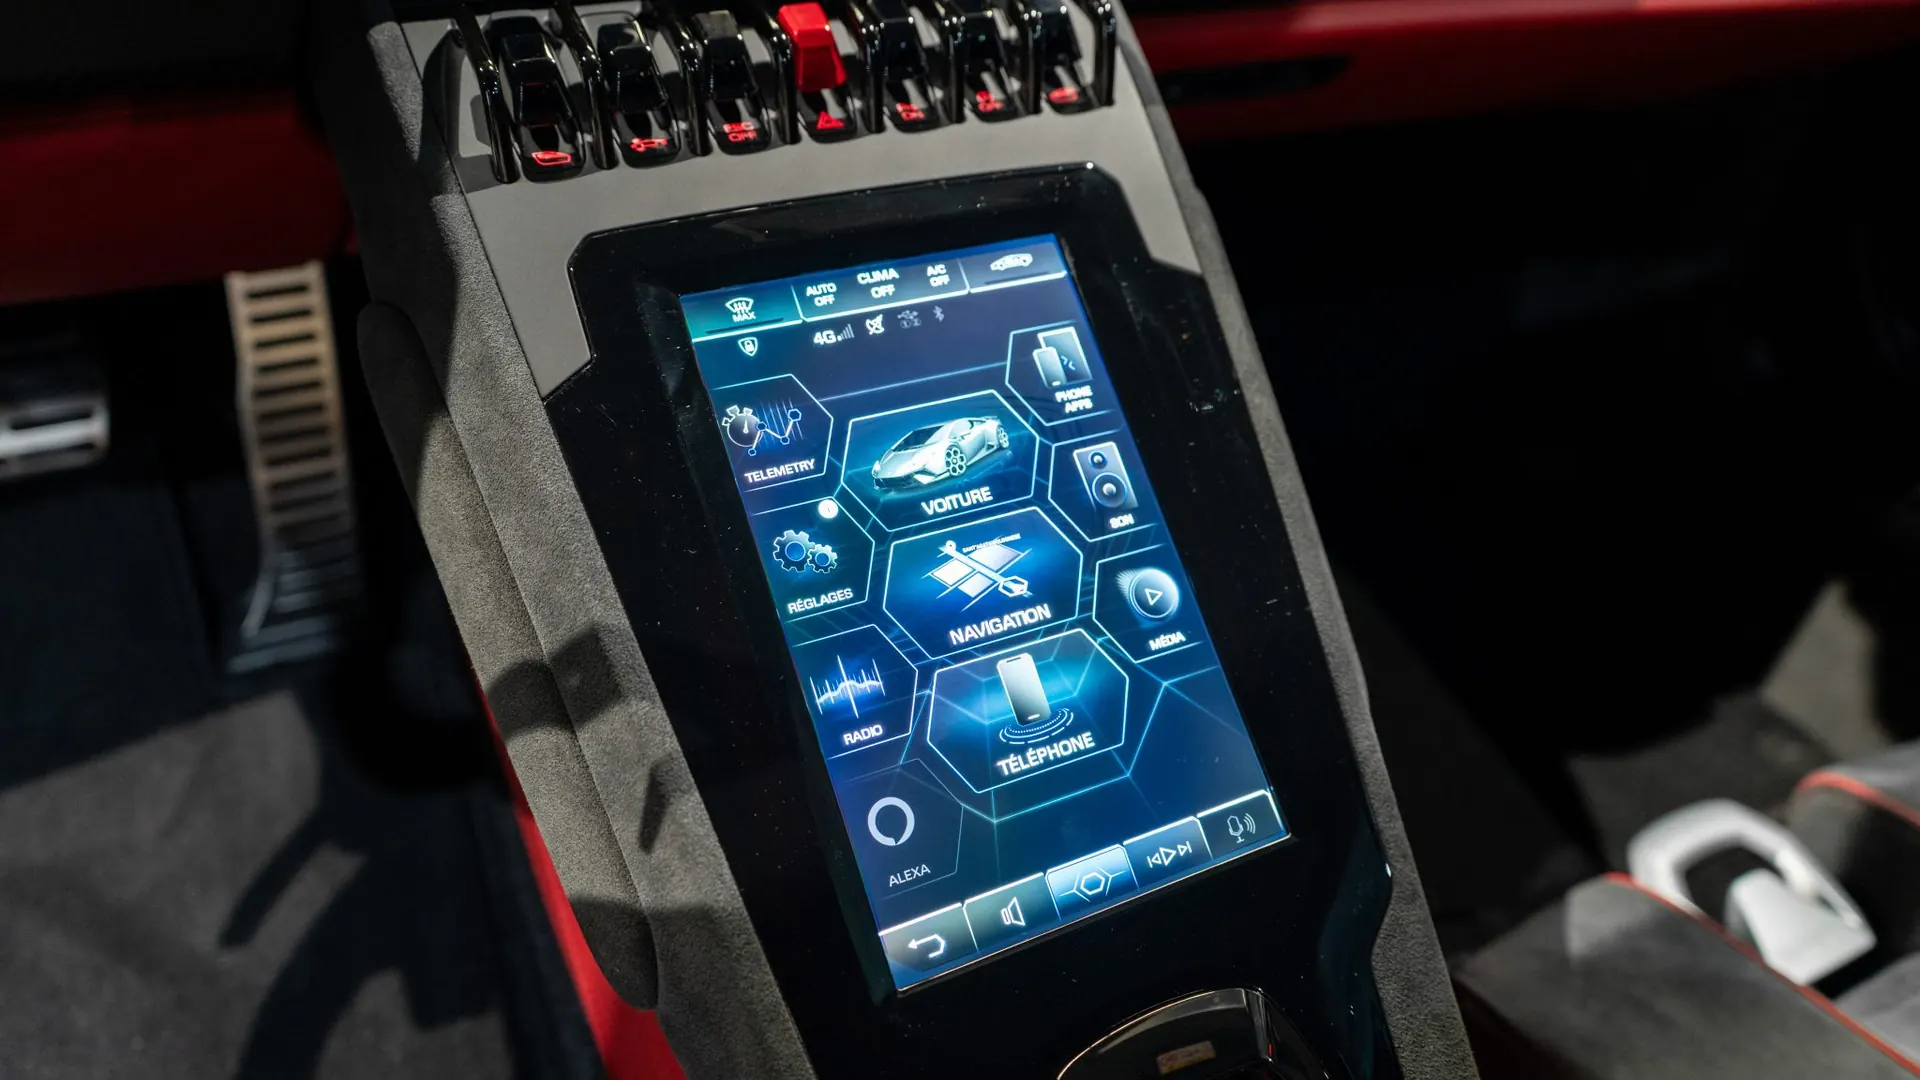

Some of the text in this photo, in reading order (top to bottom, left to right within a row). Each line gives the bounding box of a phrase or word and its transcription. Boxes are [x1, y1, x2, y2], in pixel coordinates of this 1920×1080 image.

[857, 268, 900, 285] CLIMA
[927, 264, 947, 277] A/C
[806, 283, 837, 297] AUTO
[929, 275, 950, 288] OFF
[814, 294, 835, 307] OFF
[871, 285, 896, 299] OFF
[732, 312, 756, 323] MAX
[813, 330, 837, 346] 4G
[1055, 385, 1094, 403] PHONE
[1065, 398, 1094, 414] APPS
[744, 458, 816, 484] TELEMETRY
[921, 486, 994, 516] VOITURE
[1109, 513, 1135, 530] SON
[787, 587, 854, 614] RÉGLAGES
[950, 603, 1052, 646] NAVIGATION
[1148, 631, 1187, 651] MÉDIA
[843, 724, 884, 746] RADIO
[997, 731, 1096, 776] TÉLÉPHONE
[889, 863, 931, 887] ALEXA
